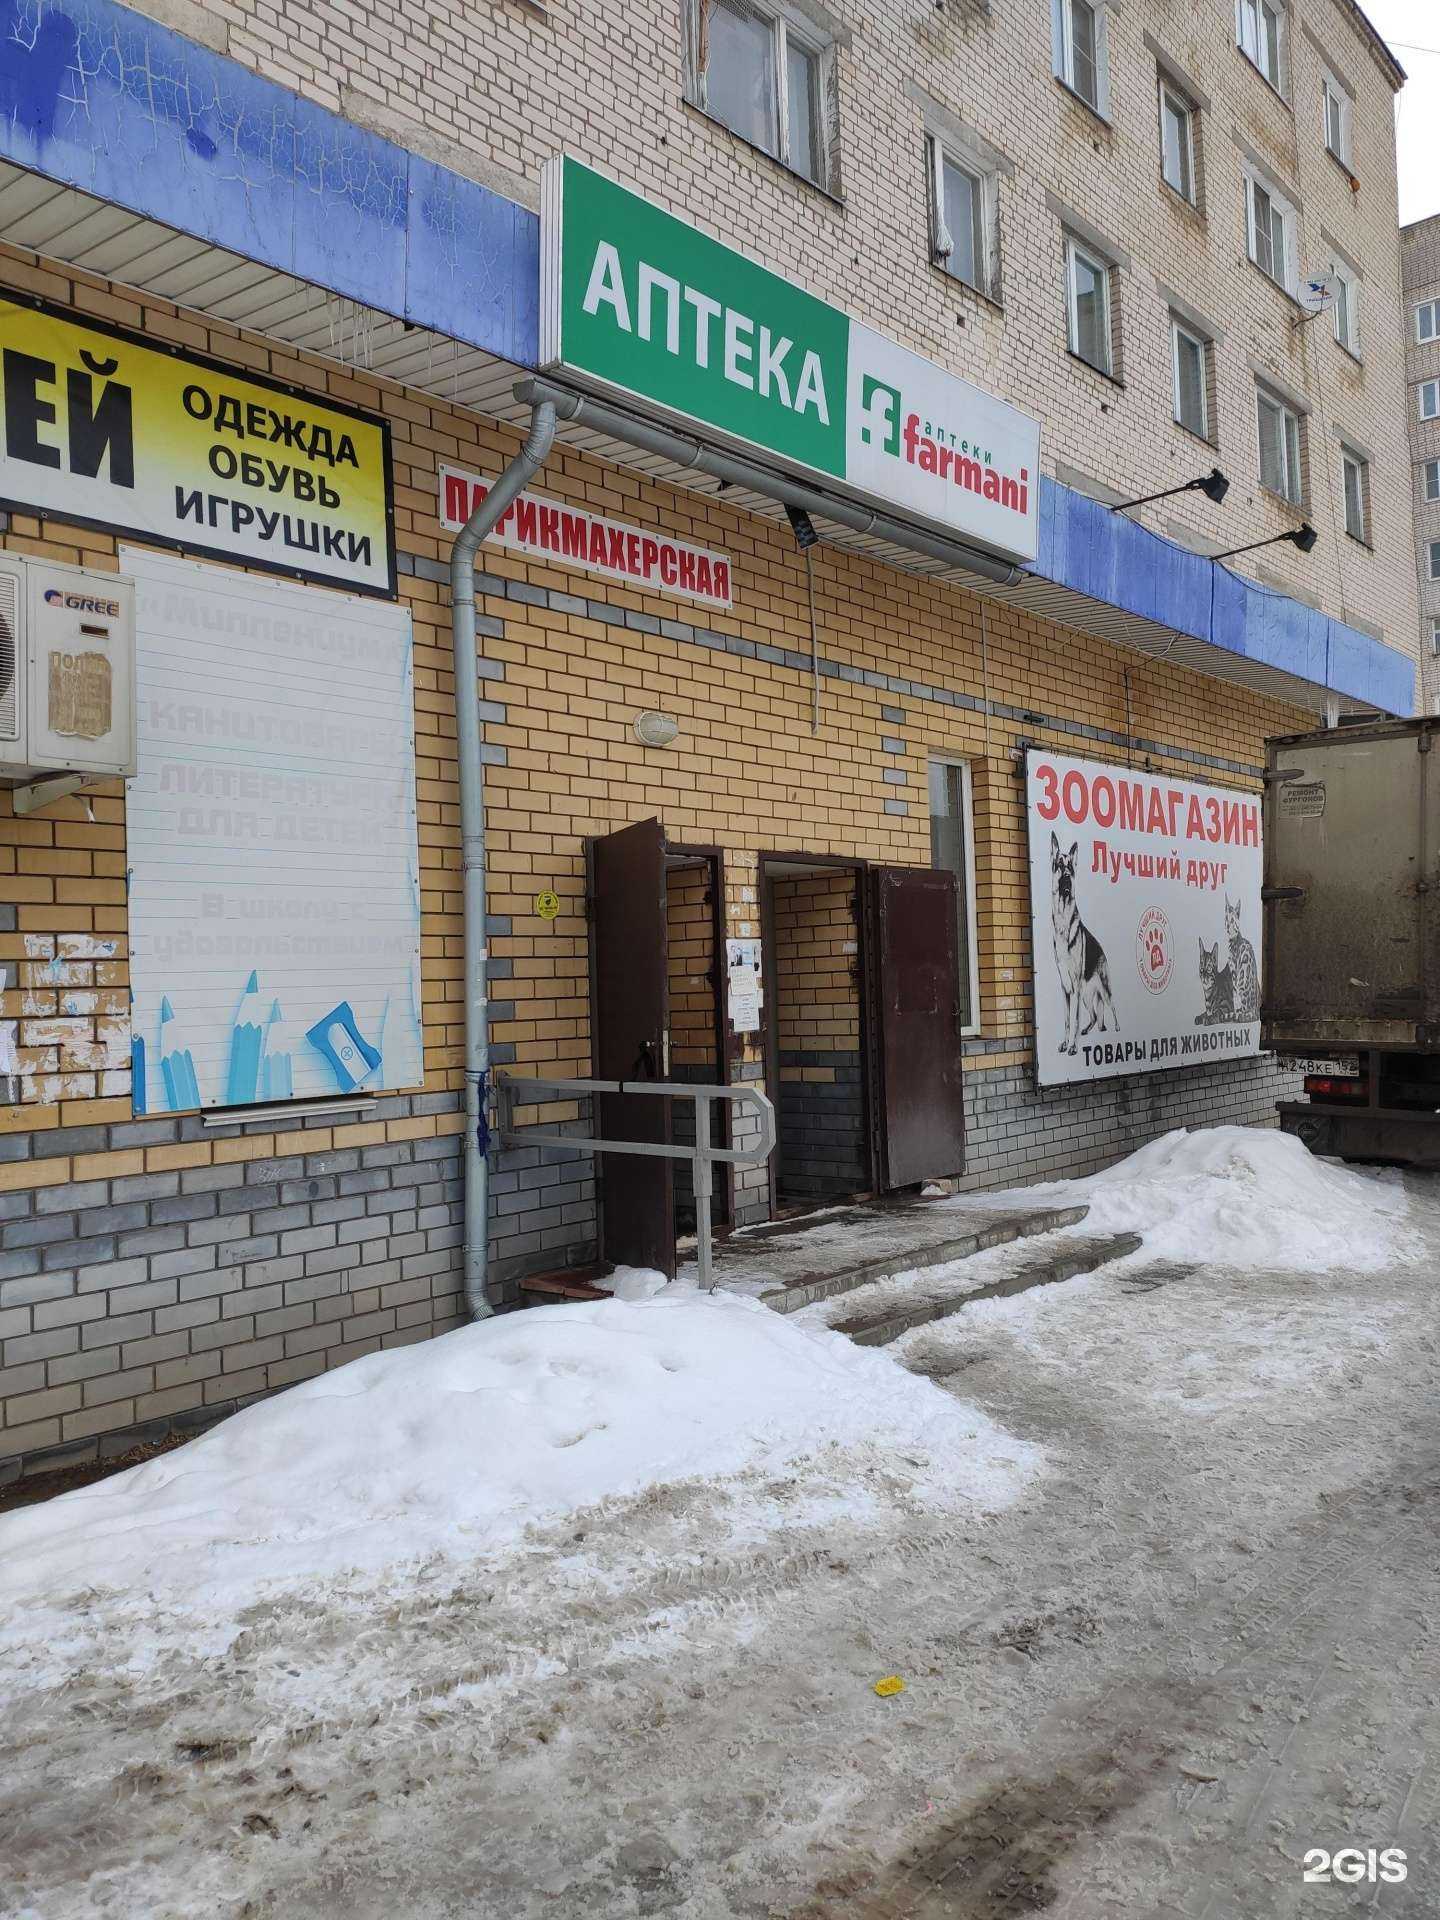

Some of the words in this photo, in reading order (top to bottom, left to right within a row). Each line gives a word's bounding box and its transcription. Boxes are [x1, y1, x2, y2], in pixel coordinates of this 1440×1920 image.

[582, 240, 830, 426] АПТЕКА
[182, 384, 360, 468] ОДЕЖДА
[924, 421, 992, 465] аптеки
[208, 445, 341, 509] ОБУВЬ
[904, 414, 1028, 515] farmani
[175, 486, 372, 566] ИГРУШКИ
[66, 596, 120, 618] GREE
[177, 807, 258, 838] ДЛЯ
[1035, 764, 1259, 848] ЗООМАГАЗИН
[1091, 841, 1181, 884] Лучший
[1186, 860, 1228, 891] друг
[1082, 1039, 1146, 1067] ТОВАРЫ
[1150, 1037, 1178, 1062] ДЛЯ
[1180, 1028, 1251, 1053] ЖИВОТНЫХ
